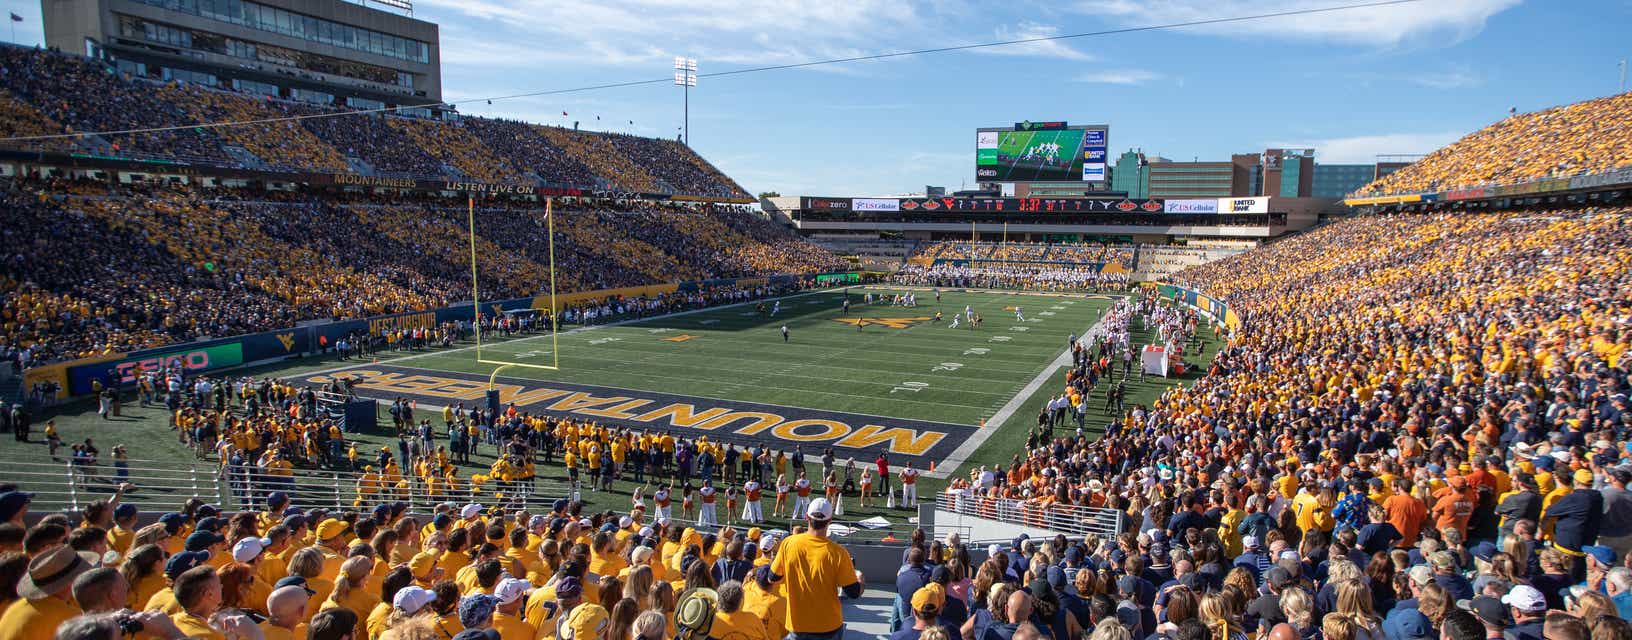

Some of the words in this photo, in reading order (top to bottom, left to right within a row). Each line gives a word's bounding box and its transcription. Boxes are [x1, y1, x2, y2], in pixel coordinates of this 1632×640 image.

[334, 174, 417, 188] MOUNTAINEERS
[446, 181, 487, 192] LISTEN
[489, 183, 513, 194] LIVE
[517, 185, 535, 195] ON
[307, 370, 949, 457] MOUNTAINEERS
